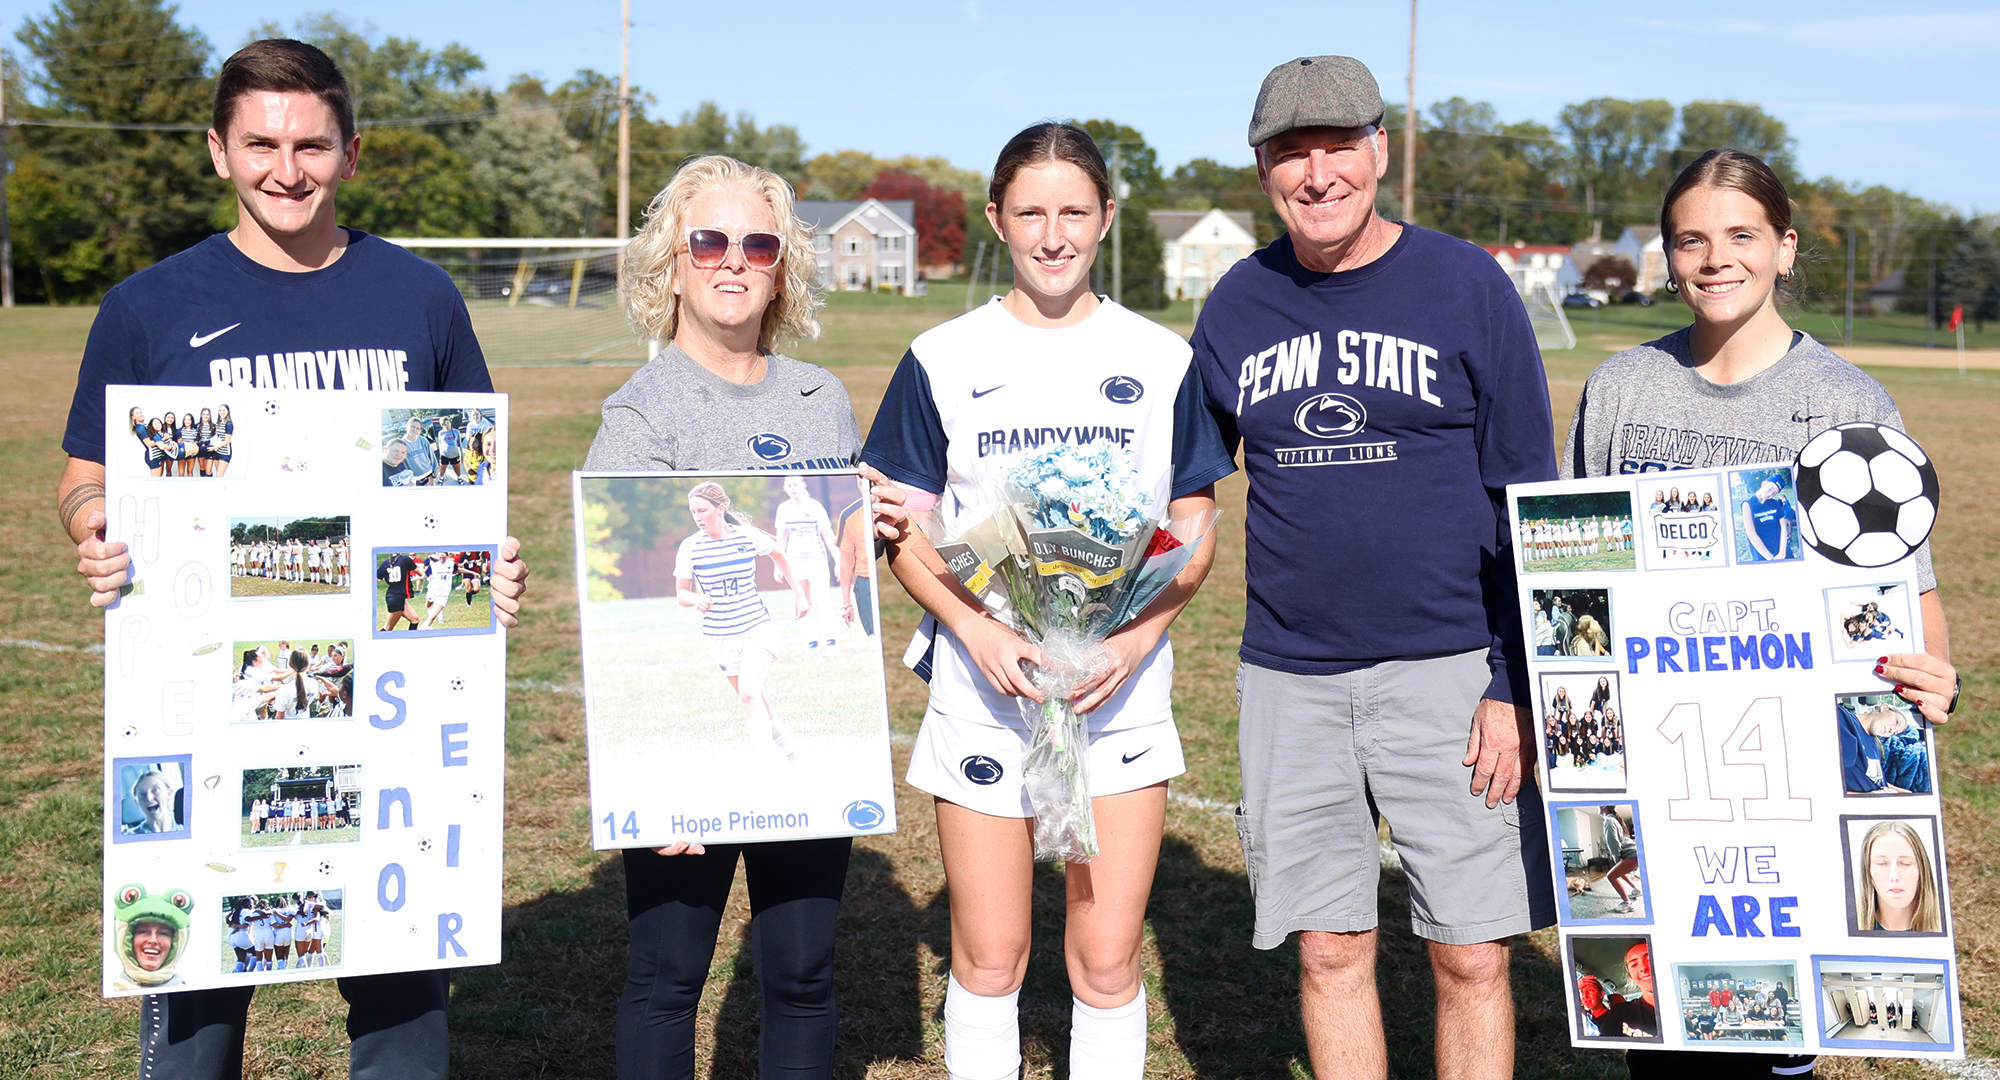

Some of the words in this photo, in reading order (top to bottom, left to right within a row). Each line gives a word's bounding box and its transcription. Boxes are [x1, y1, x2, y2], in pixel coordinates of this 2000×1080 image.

[1236, 331, 1322, 417] PENN
[1337, 329, 1441, 408] STATE
[1620, 423, 1799, 468] BRANDYWIN
[1659, 522, 1708, 540] DELCO
[1061, 546, 1118, 568] BUNCHES
[722, 577, 739, 597] 14
[1668, 598, 1780, 636] CAPT.
[1625, 631, 1814, 675] PRIEMON
[1656, 696, 1813, 822] 14
[603, 811, 640, 841] 14
[671, 814, 722, 838] Hope
[728, 811, 809, 831] Priemon
[1693, 845, 1781, 885] WE
[1691, 894, 1802, 938] ARE
